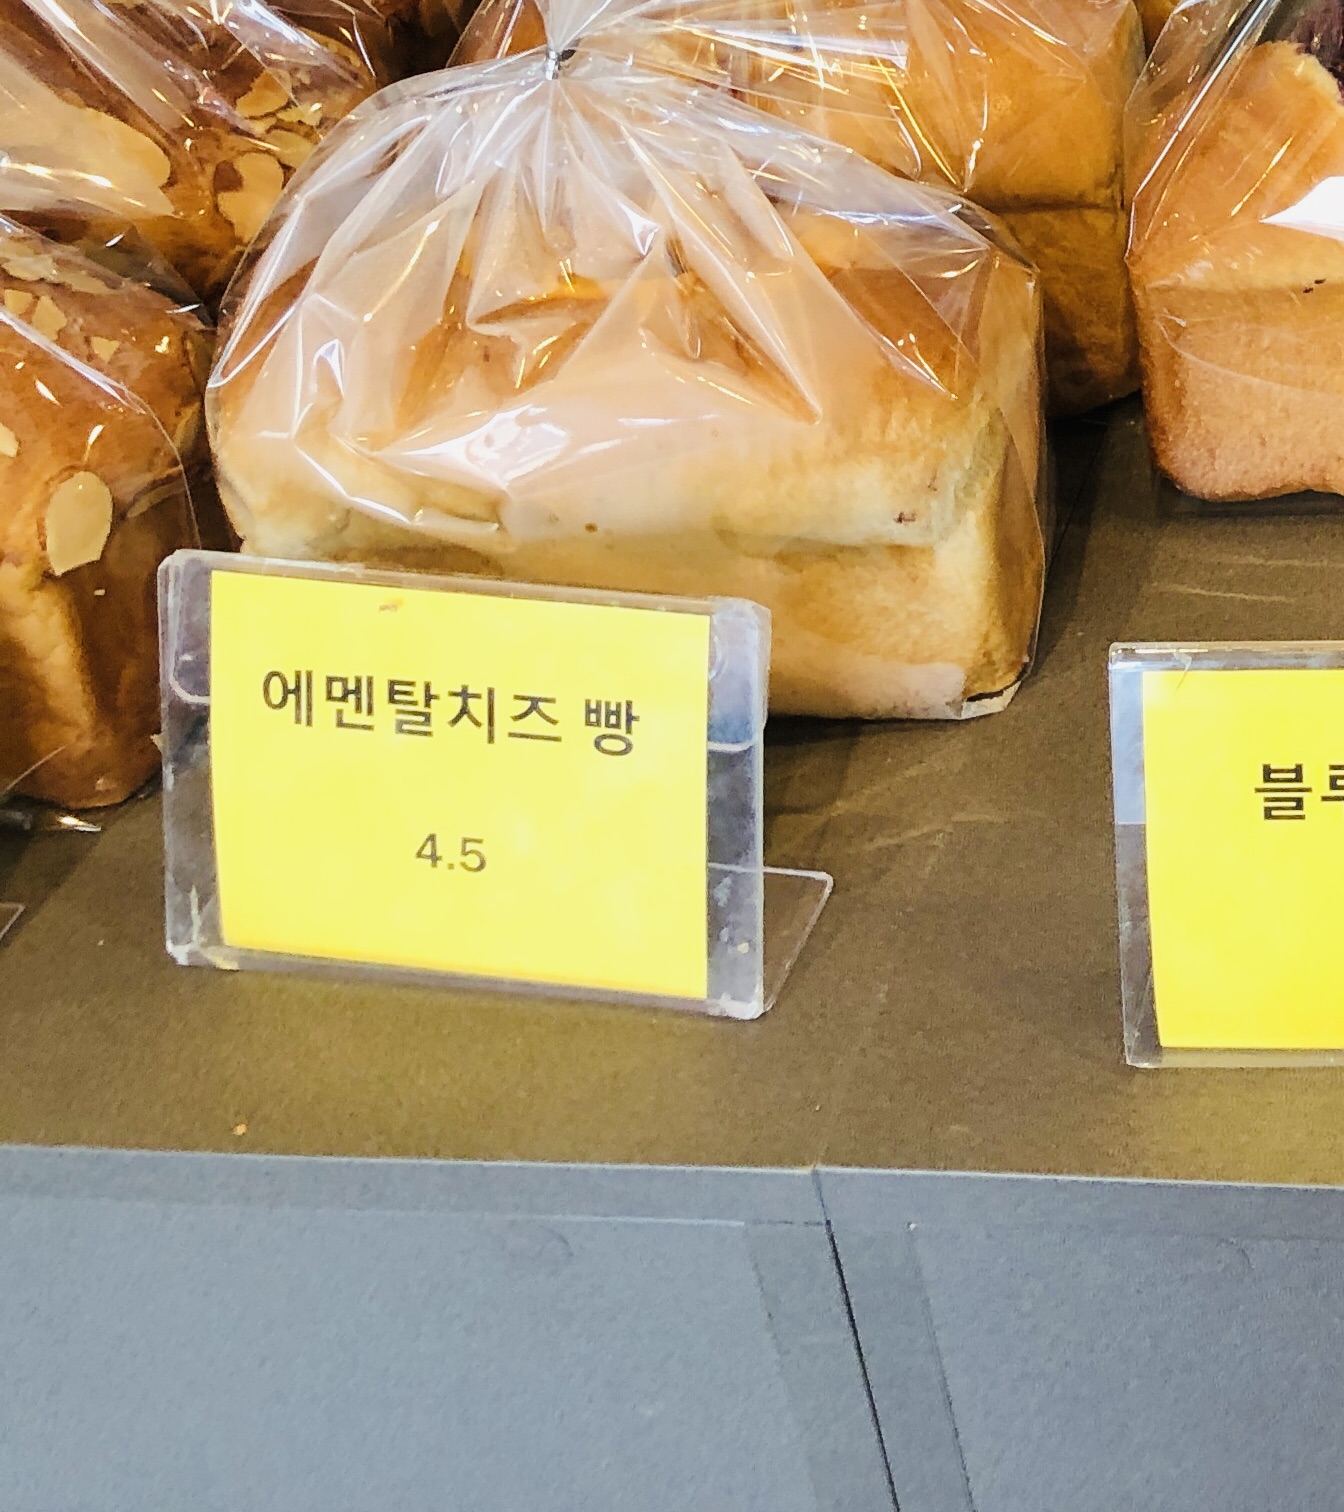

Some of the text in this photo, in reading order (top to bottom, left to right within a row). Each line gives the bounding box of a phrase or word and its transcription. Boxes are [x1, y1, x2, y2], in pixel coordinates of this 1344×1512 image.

[261, 669, 641, 757] 에멘탈치즈 빵
[414, 832, 488, 874] 4.5
